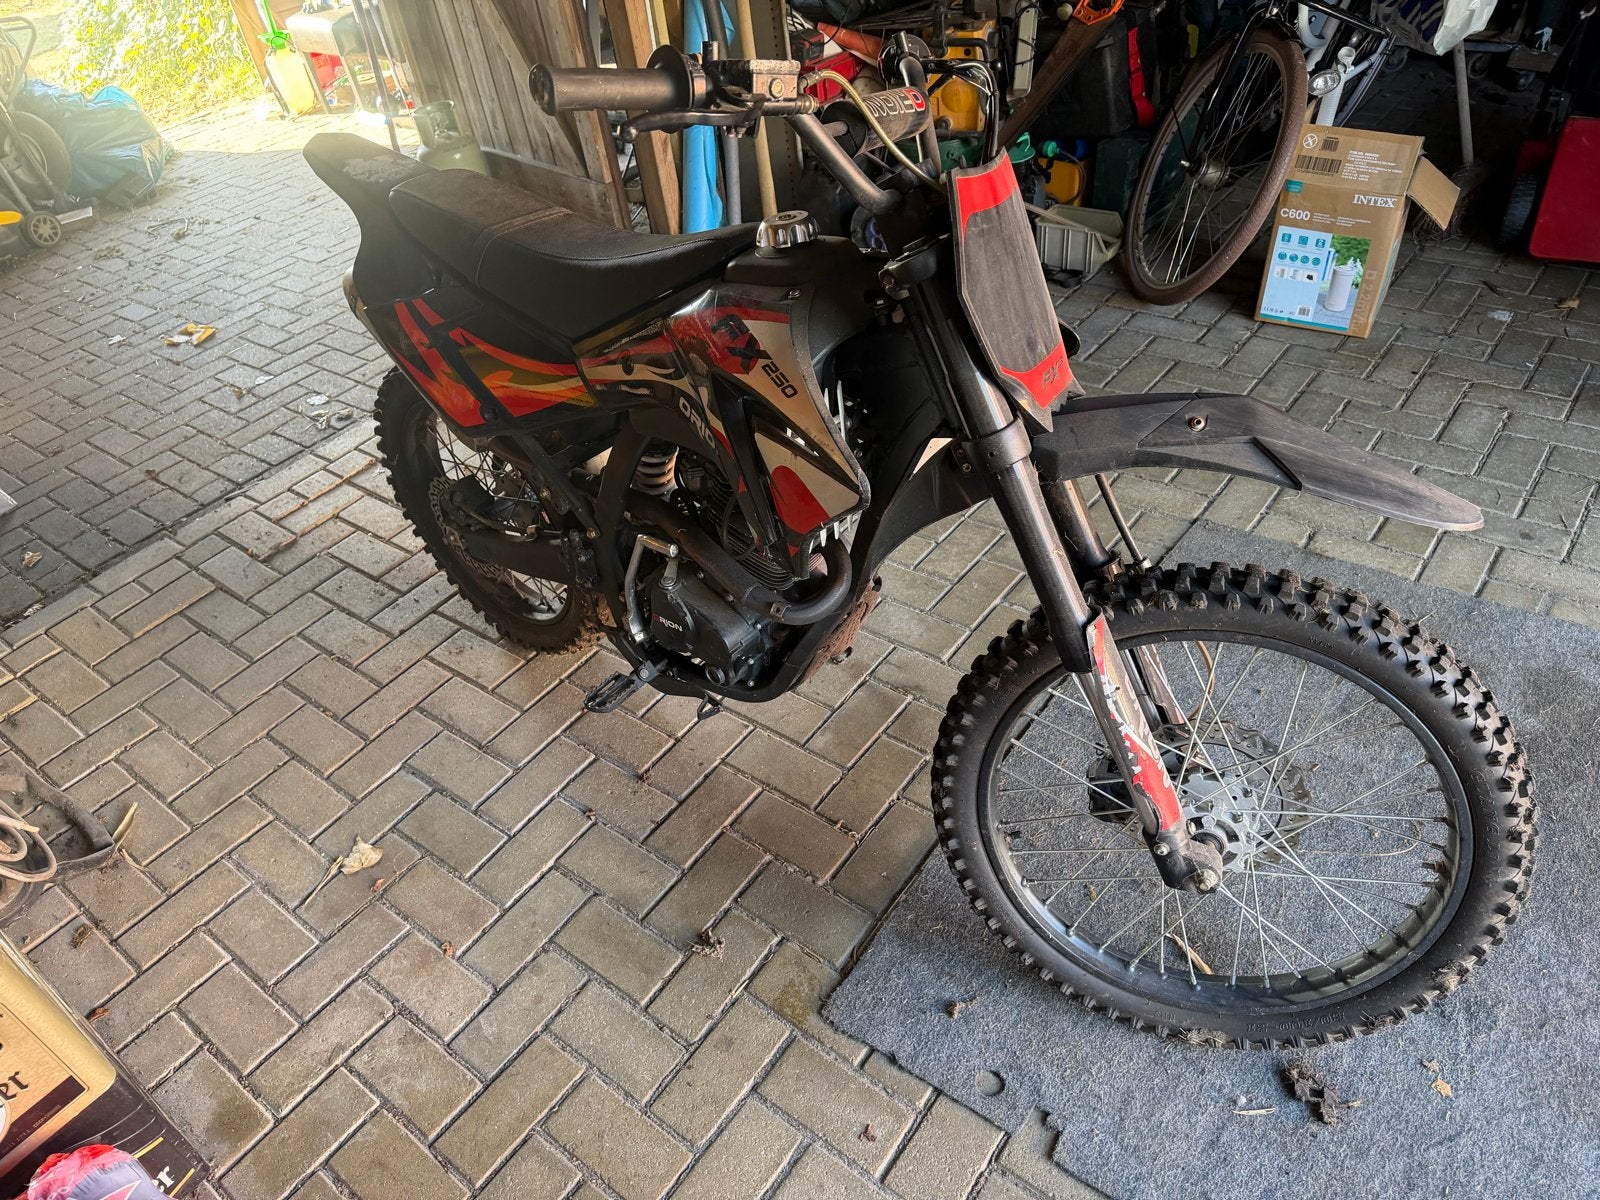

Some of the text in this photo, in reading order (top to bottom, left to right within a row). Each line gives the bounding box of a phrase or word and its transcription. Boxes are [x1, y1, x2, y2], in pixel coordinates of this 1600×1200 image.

[1352, 194, 1398, 208] INTEX
[1280, 207, 1311, 221] C600
[761, 361, 798, 399] 250
[679, 396, 718, 455] ORIO
[651, 611, 683, 632] ORION
